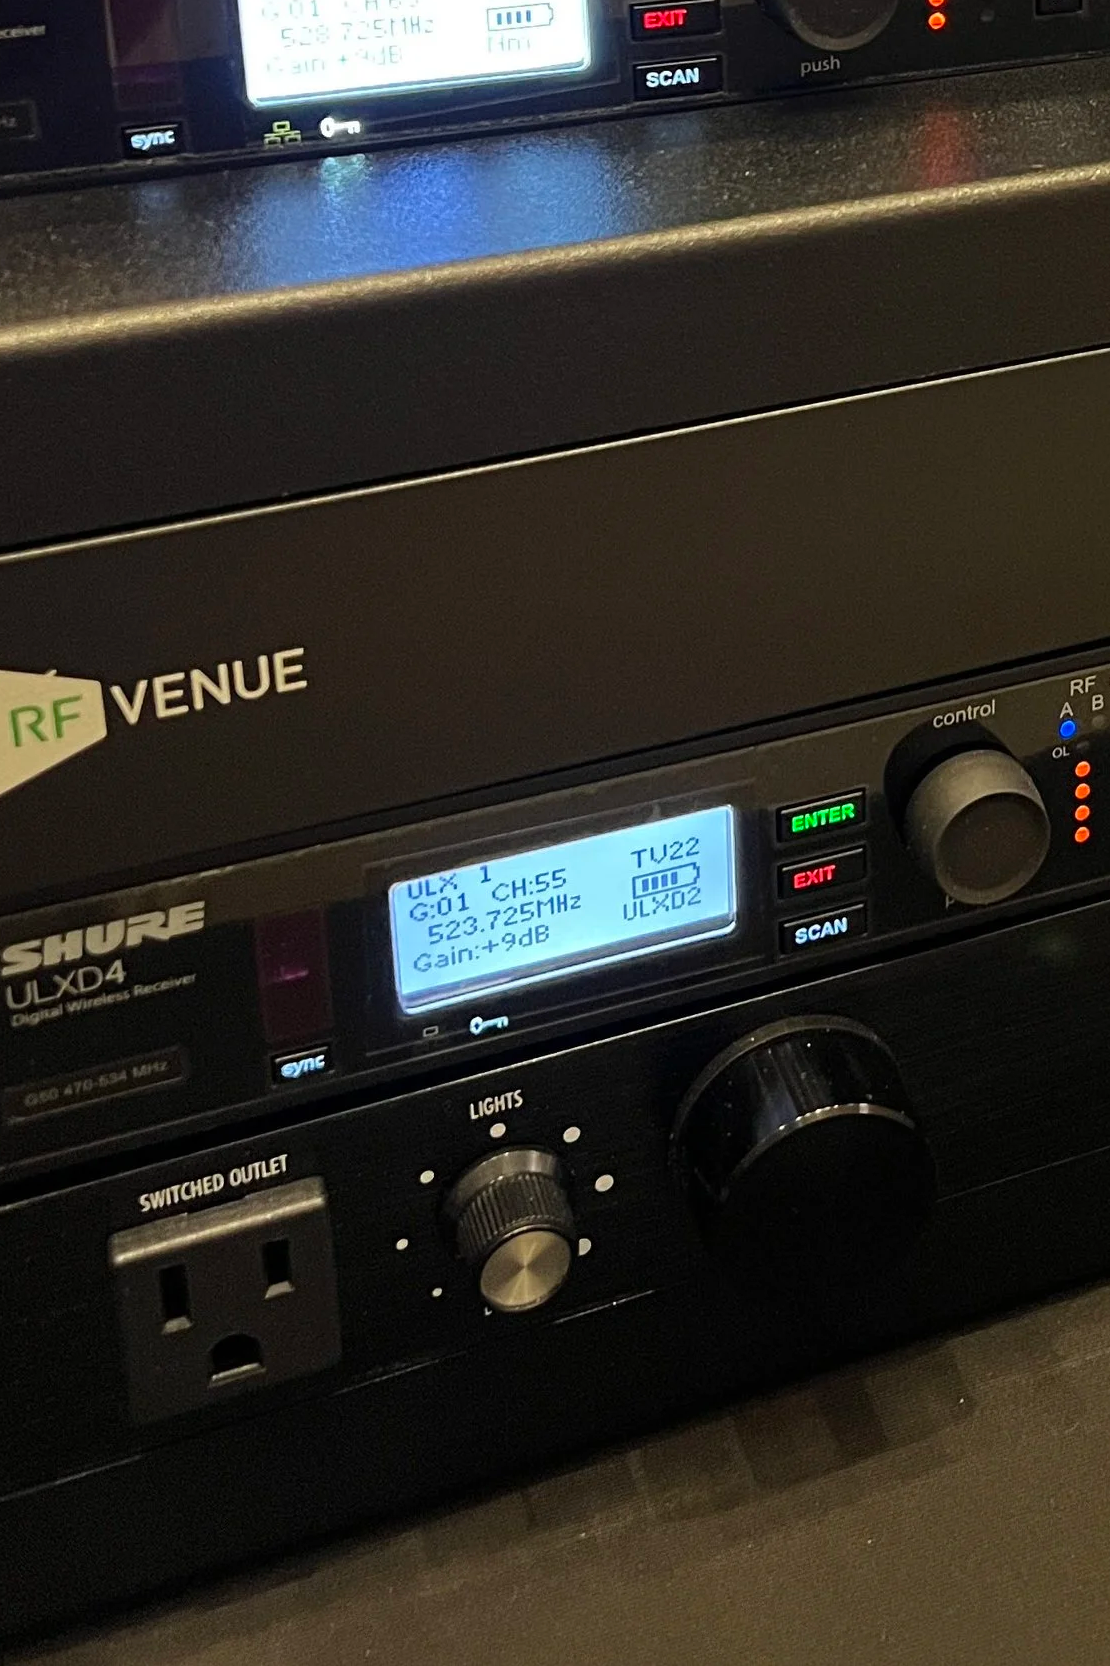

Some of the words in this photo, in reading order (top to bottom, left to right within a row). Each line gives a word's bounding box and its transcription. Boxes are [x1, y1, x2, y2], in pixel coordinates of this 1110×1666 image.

[643, 9, 688, 29] EXIT
[645, 67, 700, 87] SCAN
[801, 55, 841, 77] push
[130, 130, 175, 151] sync
[10, 695, 83, 747] RF
[109, 647, 308, 726] VENUE
[1069, 675, 1097, 697] RF
[932, 699, 996, 729] control
[791, 802, 855, 833] ENTER
[630, 837, 701, 869] TV22
[793, 864, 836, 889] EXIT
[410, 895, 470, 923] G:01
[491, 868, 567, 902] CH:55
[623, 887, 702, 922] ULXD2
[428, 894, 582, 946] 523.725MHz
[794, 916, 848, 945] SCAN
[1, 900, 205, 978] SHURE
[413, 925, 550, 973] Gain:+9dB
[5, 959, 127, 1010] ULXD4
[11, 1005, 63, 1028] Digital
[67, 989, 131, 1014] Wireless
[133, 973, 197, 996] Receiver
[280, 1054, 325, 1079] sync
[469, 1089, 523, 1120] LIGHTS
[138, 1173, 225, 1213] SWITCHED
[229, 1153, 288, 1188] OUTLET
